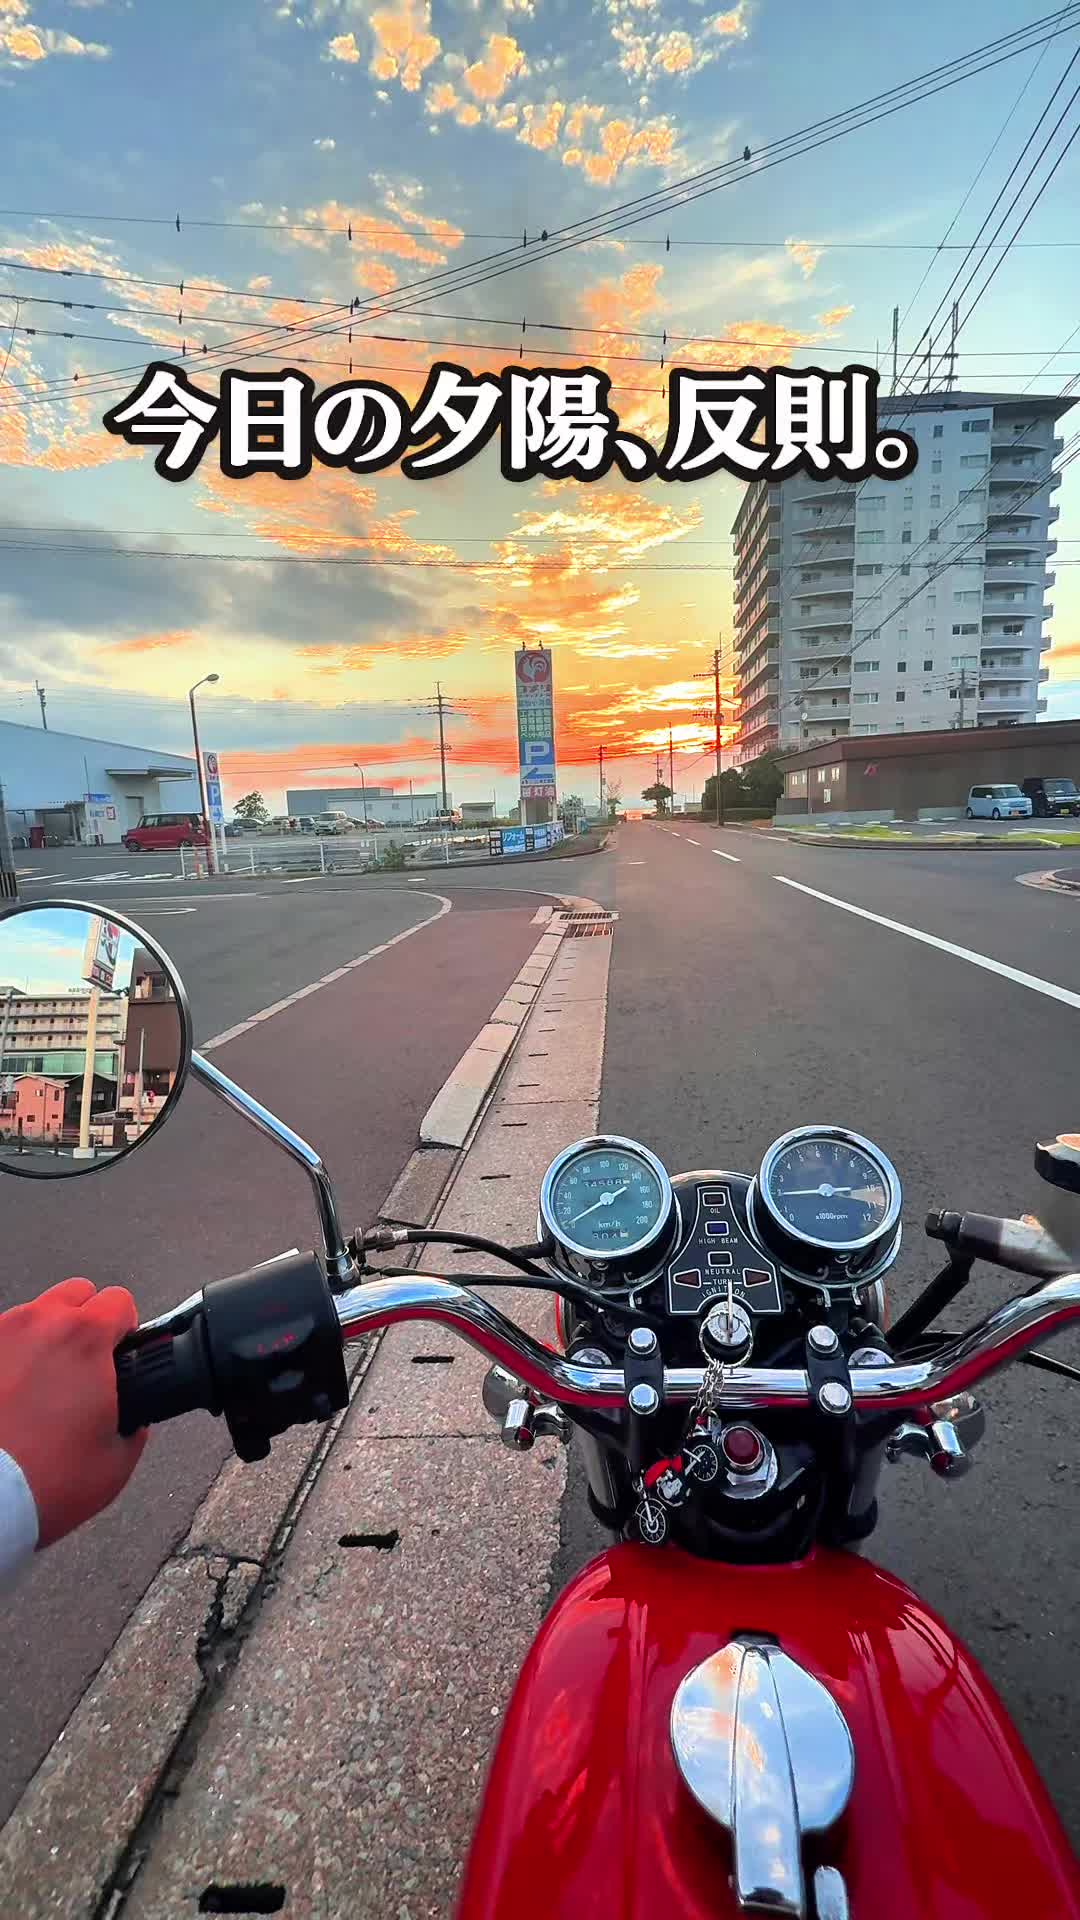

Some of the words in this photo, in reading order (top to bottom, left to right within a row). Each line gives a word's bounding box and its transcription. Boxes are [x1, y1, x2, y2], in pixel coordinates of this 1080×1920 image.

[525, 741, 550, 764] P
[212, 785, 219, 804] P
[599, 1160, 610, 1169] 100
[618, 1162, 629, 1171] 120
[582, 1166, 591, 1174] 80
[631, 1172, 642, 1181] 140
[639, 1186, 650, 1194] 160
[563, 1192, 572, 1200] 40
[642, 1200, 653, 1209] 180
[598, 1220, 621, 1229] km/h
[635, 1216, 648, 1225] 200
[701, 1285, 746, 1299] IGNITON
